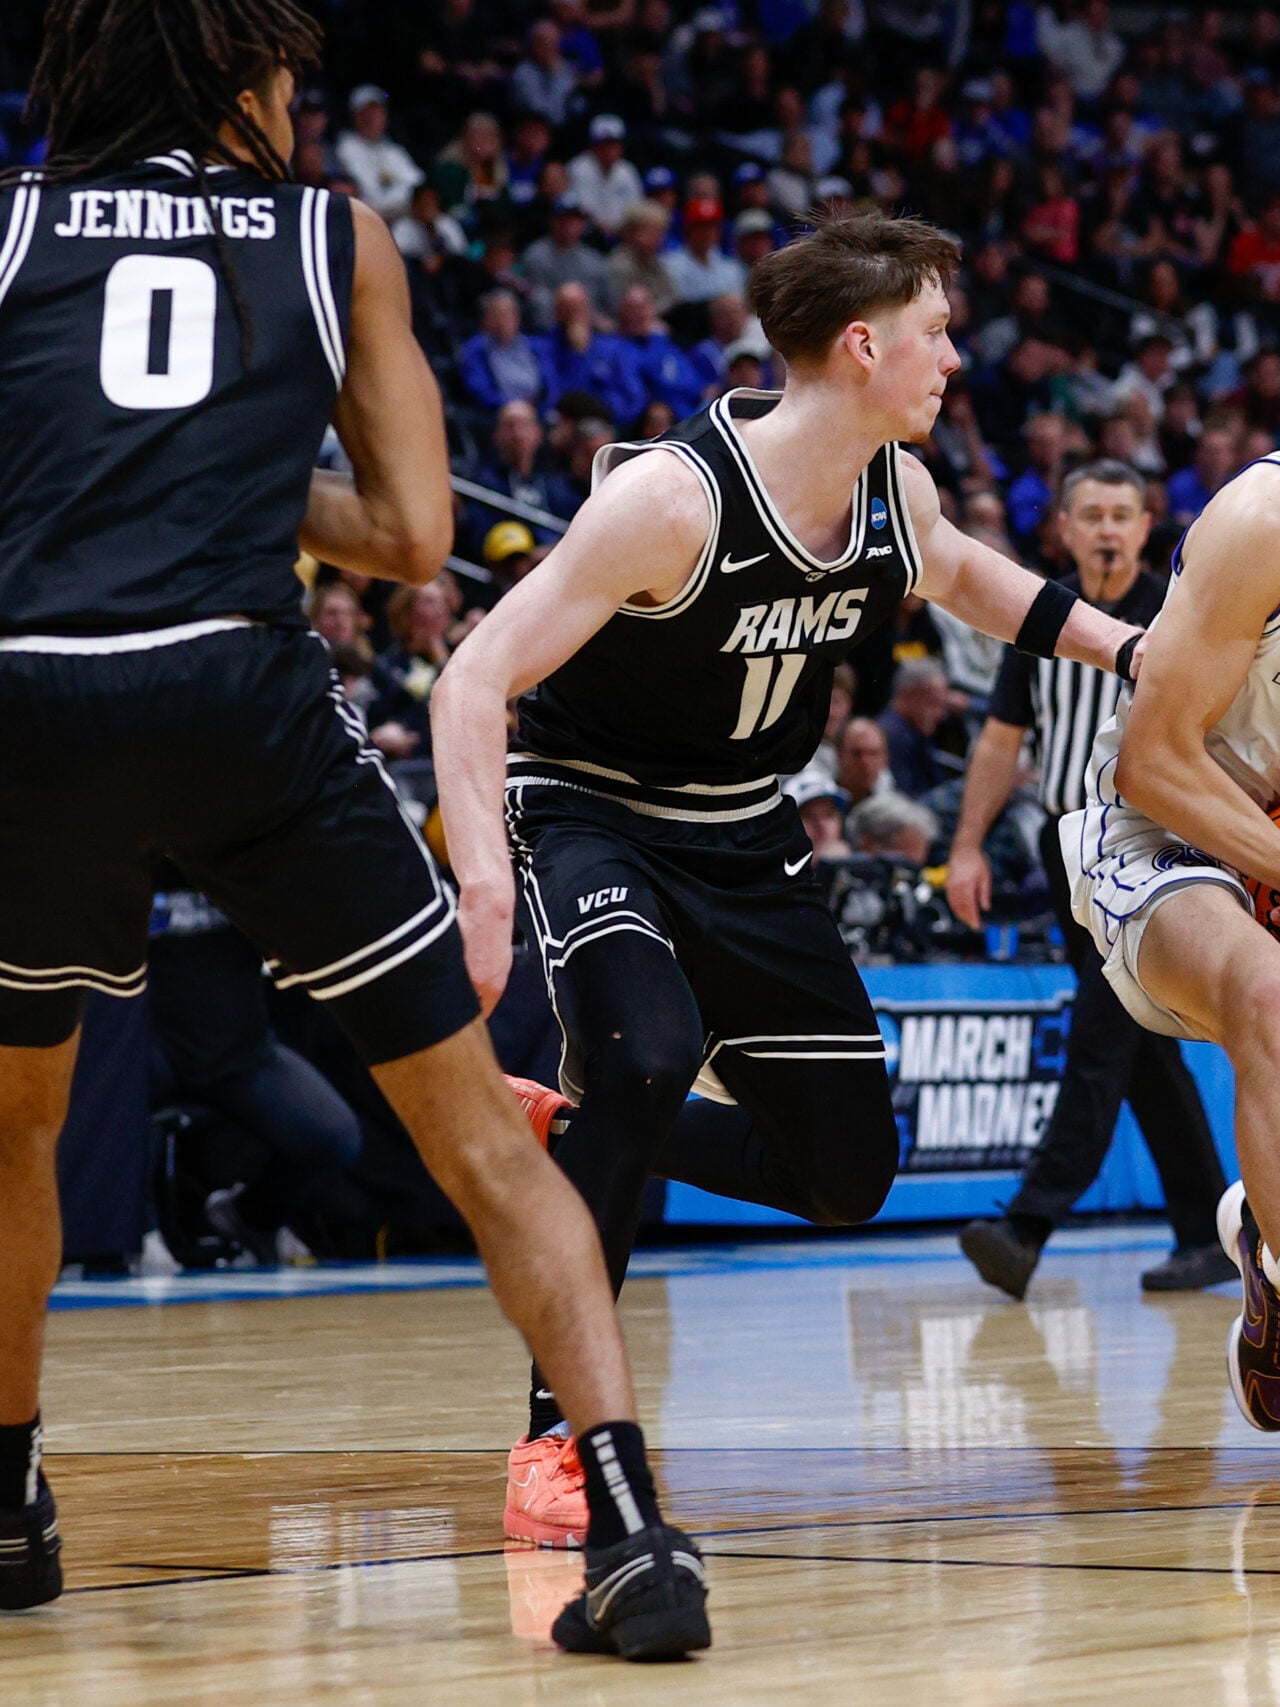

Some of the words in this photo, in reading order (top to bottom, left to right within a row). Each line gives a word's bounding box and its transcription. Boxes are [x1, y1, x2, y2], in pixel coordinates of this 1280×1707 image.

[54, 189, 277, 240] JENNINGS
[100, 253, 218, 411] 0
[718, 587, 870, 654] RAMS
[728, 653, 808, 740] 11
[576, 886, 629, 915] VCU
[898, 1014, 1033, 1082] MARCH
[915, 1079, 1061, 1149] MADNE
